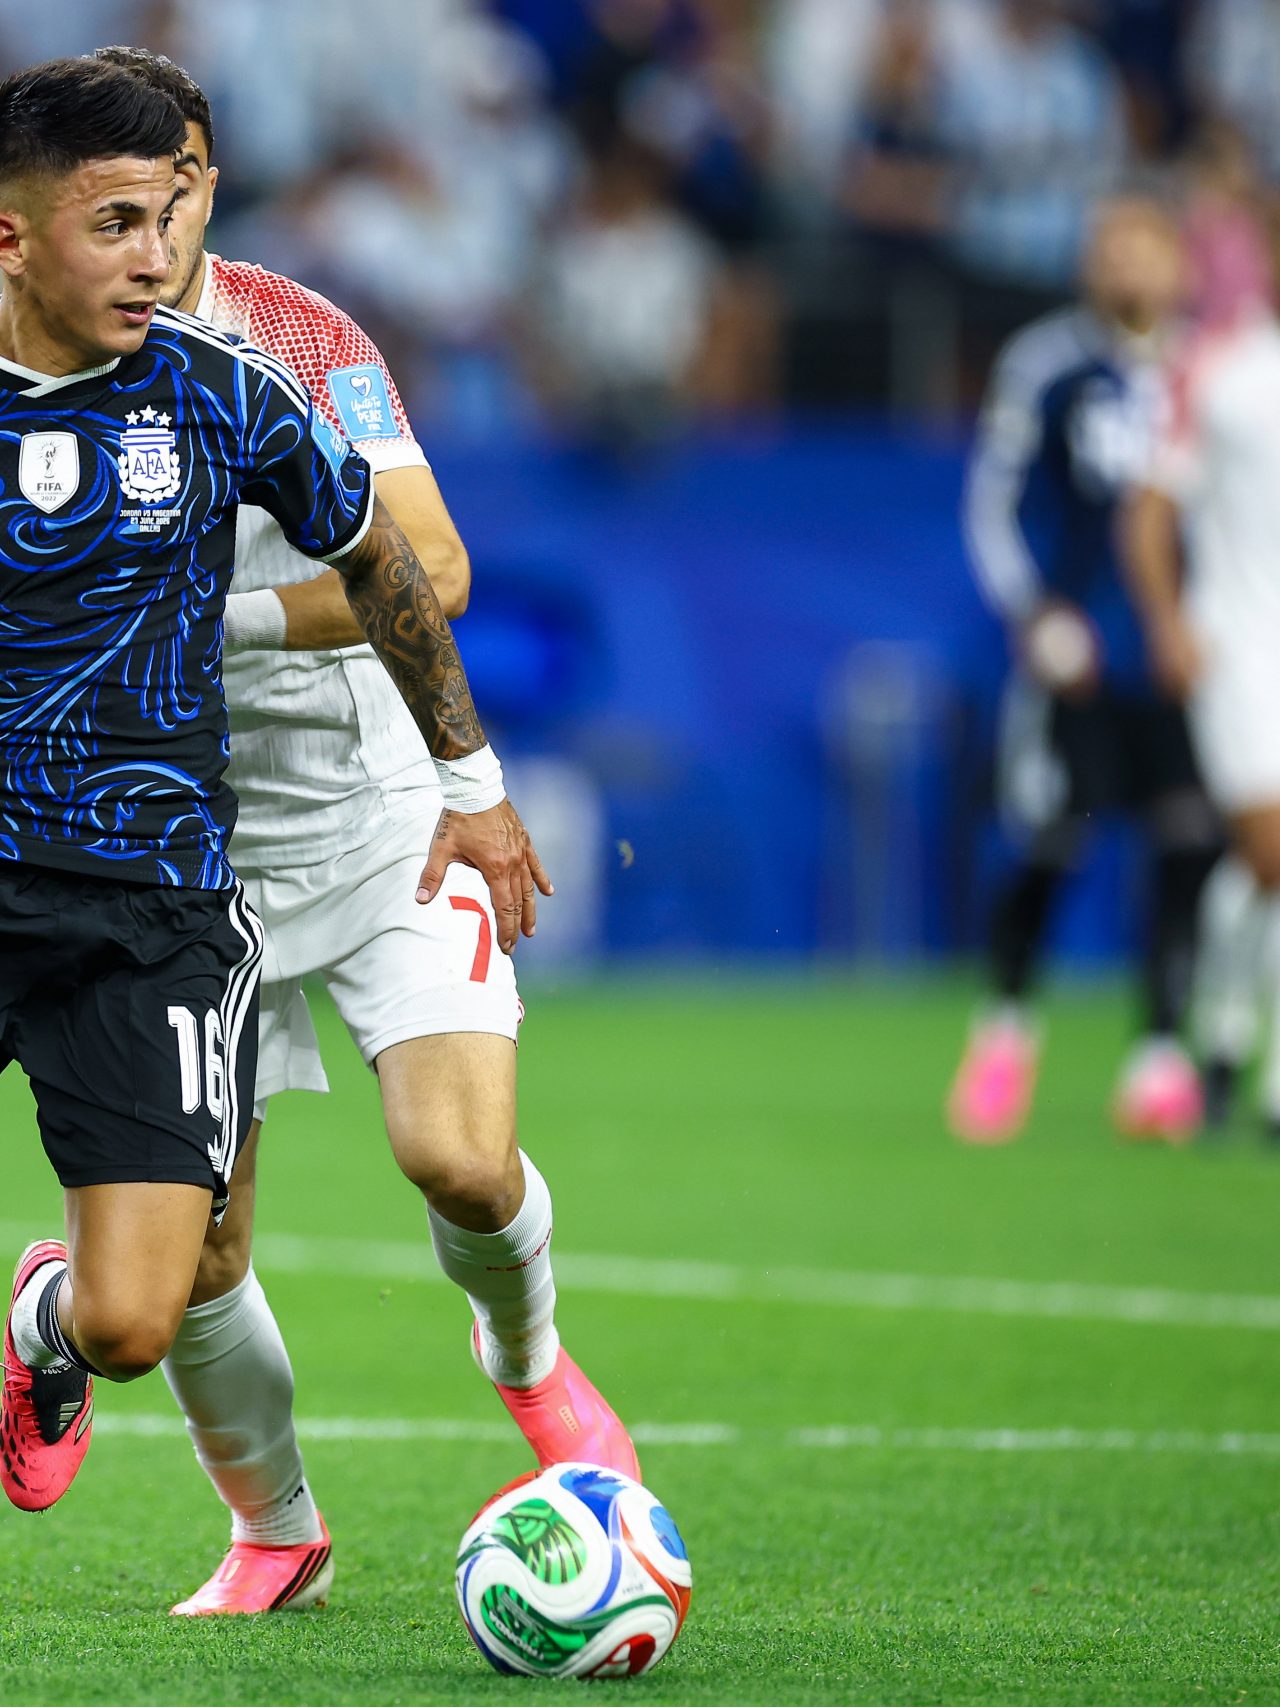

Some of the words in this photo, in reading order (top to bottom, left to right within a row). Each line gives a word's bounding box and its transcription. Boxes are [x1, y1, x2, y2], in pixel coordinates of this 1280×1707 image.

[132, 448, 167, 480] AFA
[37, 482, 62, 492] FIFA
[120, 509, 142, 517] JORDAN
[143, 509, 151, 517] VS
[152, 509, 181, 517] ARGENTINA
[130, 517, 138, 525] 27
[139, 517, 154, 525] JUNE
[155, 517, 170, 525] 2026
[448, 896, 491, 984] 7
[167, 1005, 225, 1123] 16
[41, 1363, 71, 1375] ST.1994
